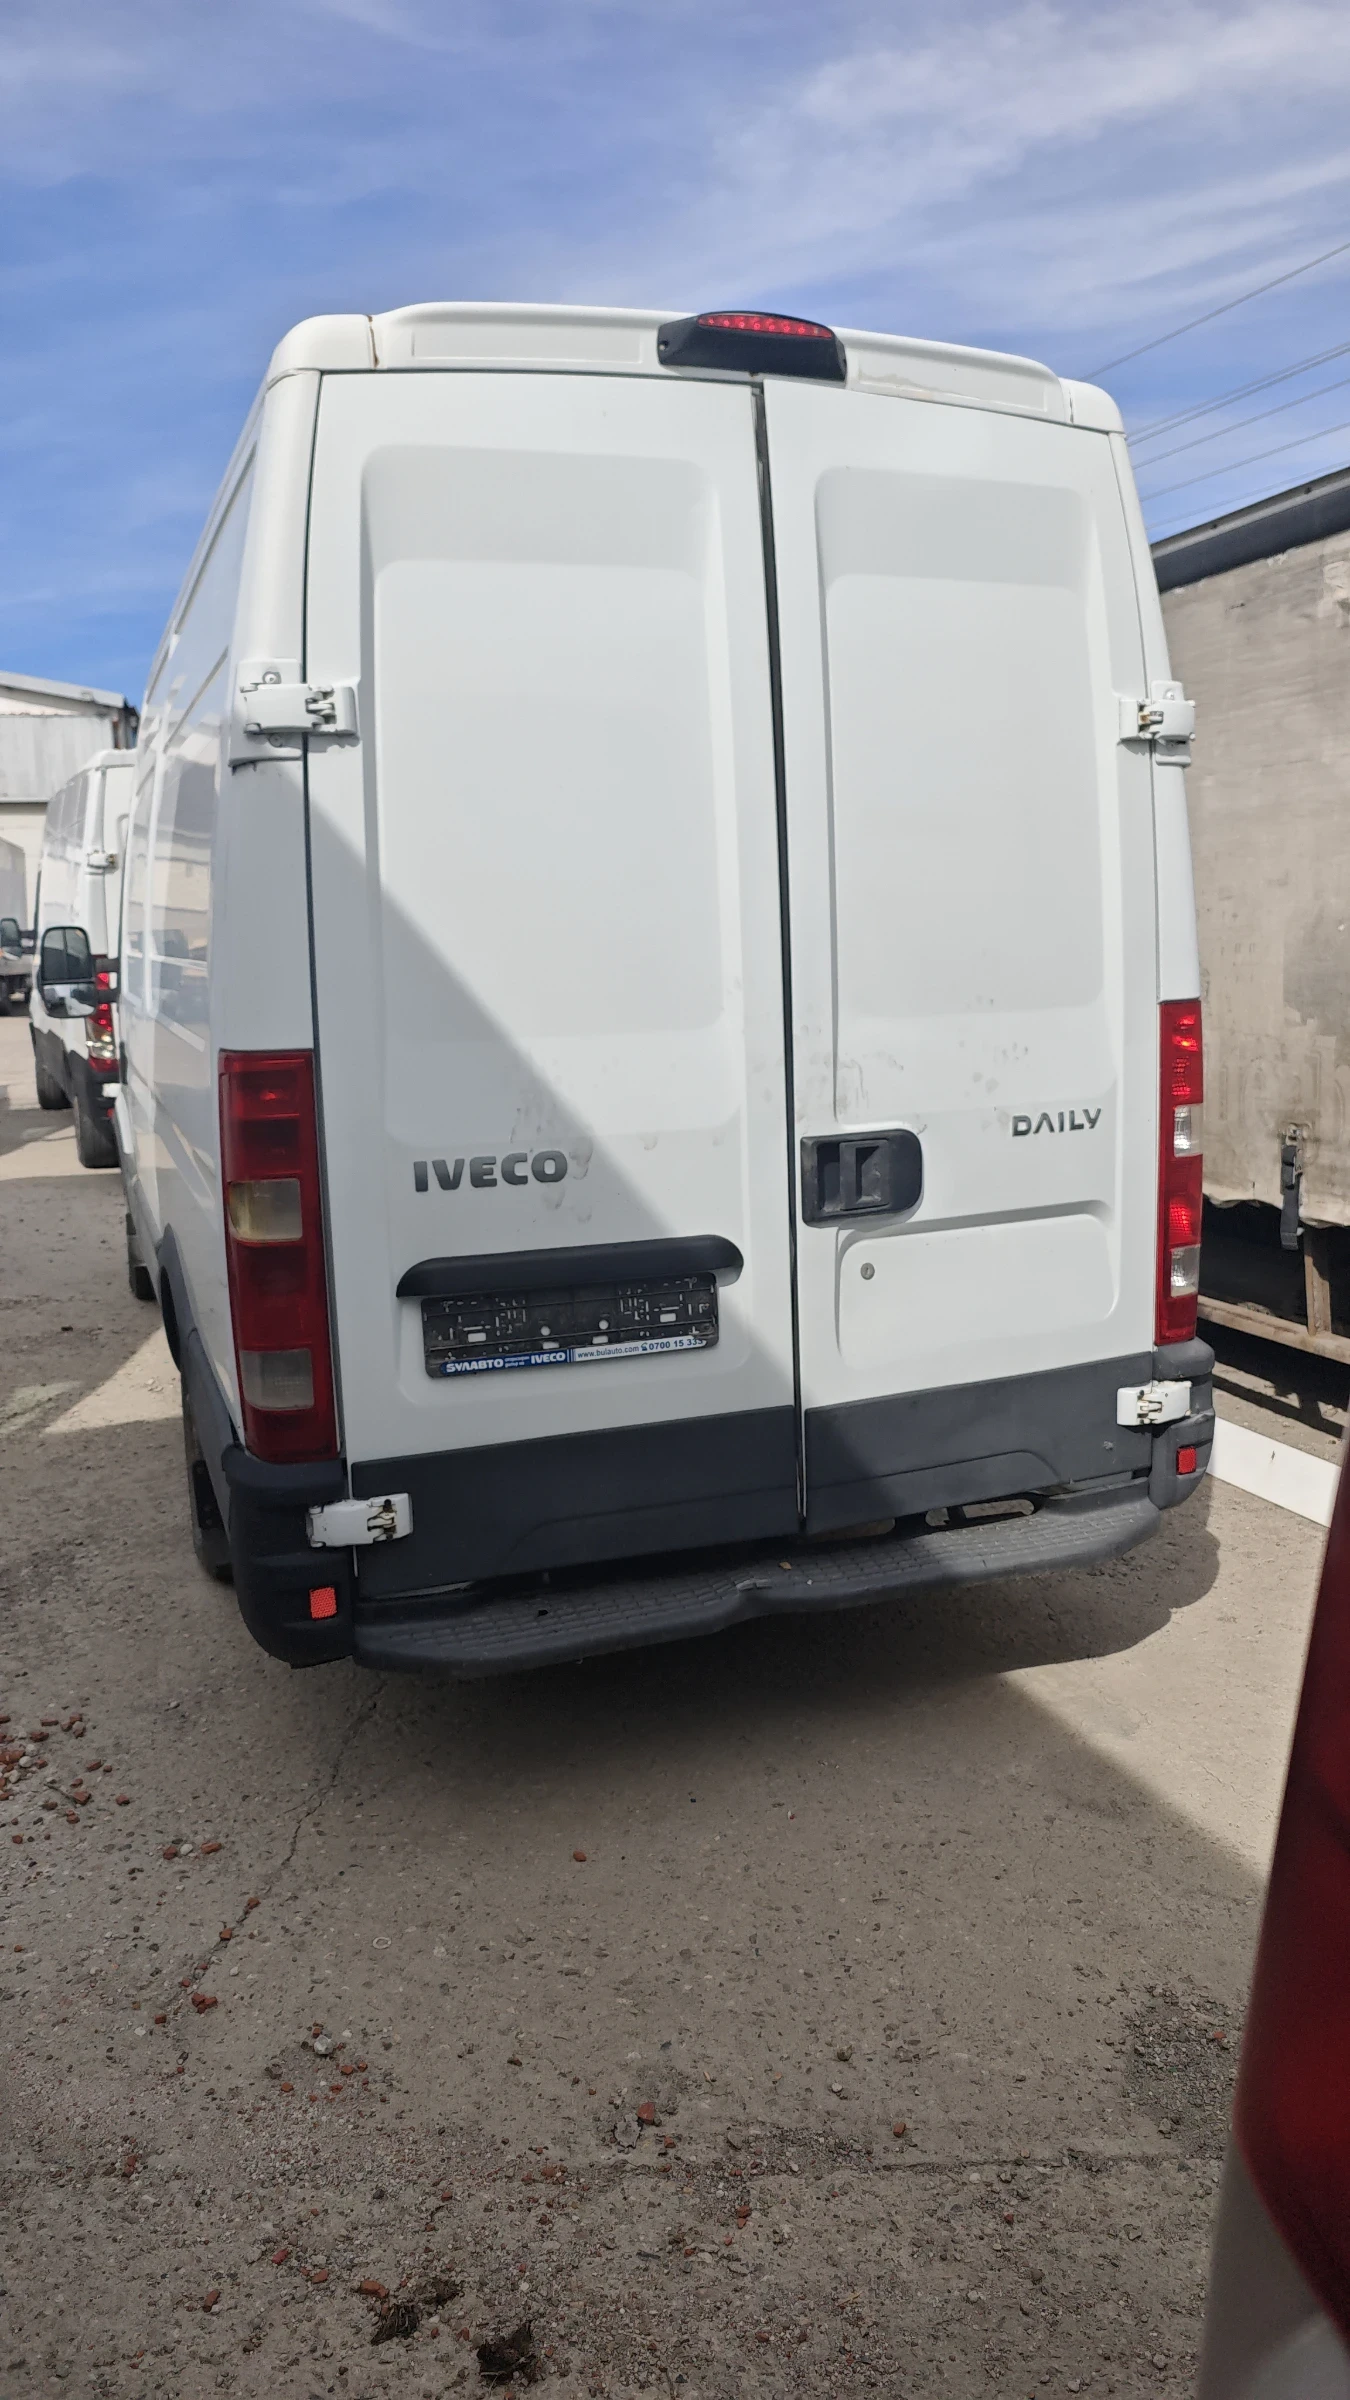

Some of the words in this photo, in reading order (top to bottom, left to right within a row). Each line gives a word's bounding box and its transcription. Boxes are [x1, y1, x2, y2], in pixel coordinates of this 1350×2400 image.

[1012, 1107, 1102, 1137] DAILY
[413, 1150, 568, 1192] IVECO
[530, 1352, 566, 1364] IVECO
[577, 1345, 640, 1358] www.bulauto.com
[649, 1340, 671, 1350] 0700
[673, 1339, 684, 1347] 15
